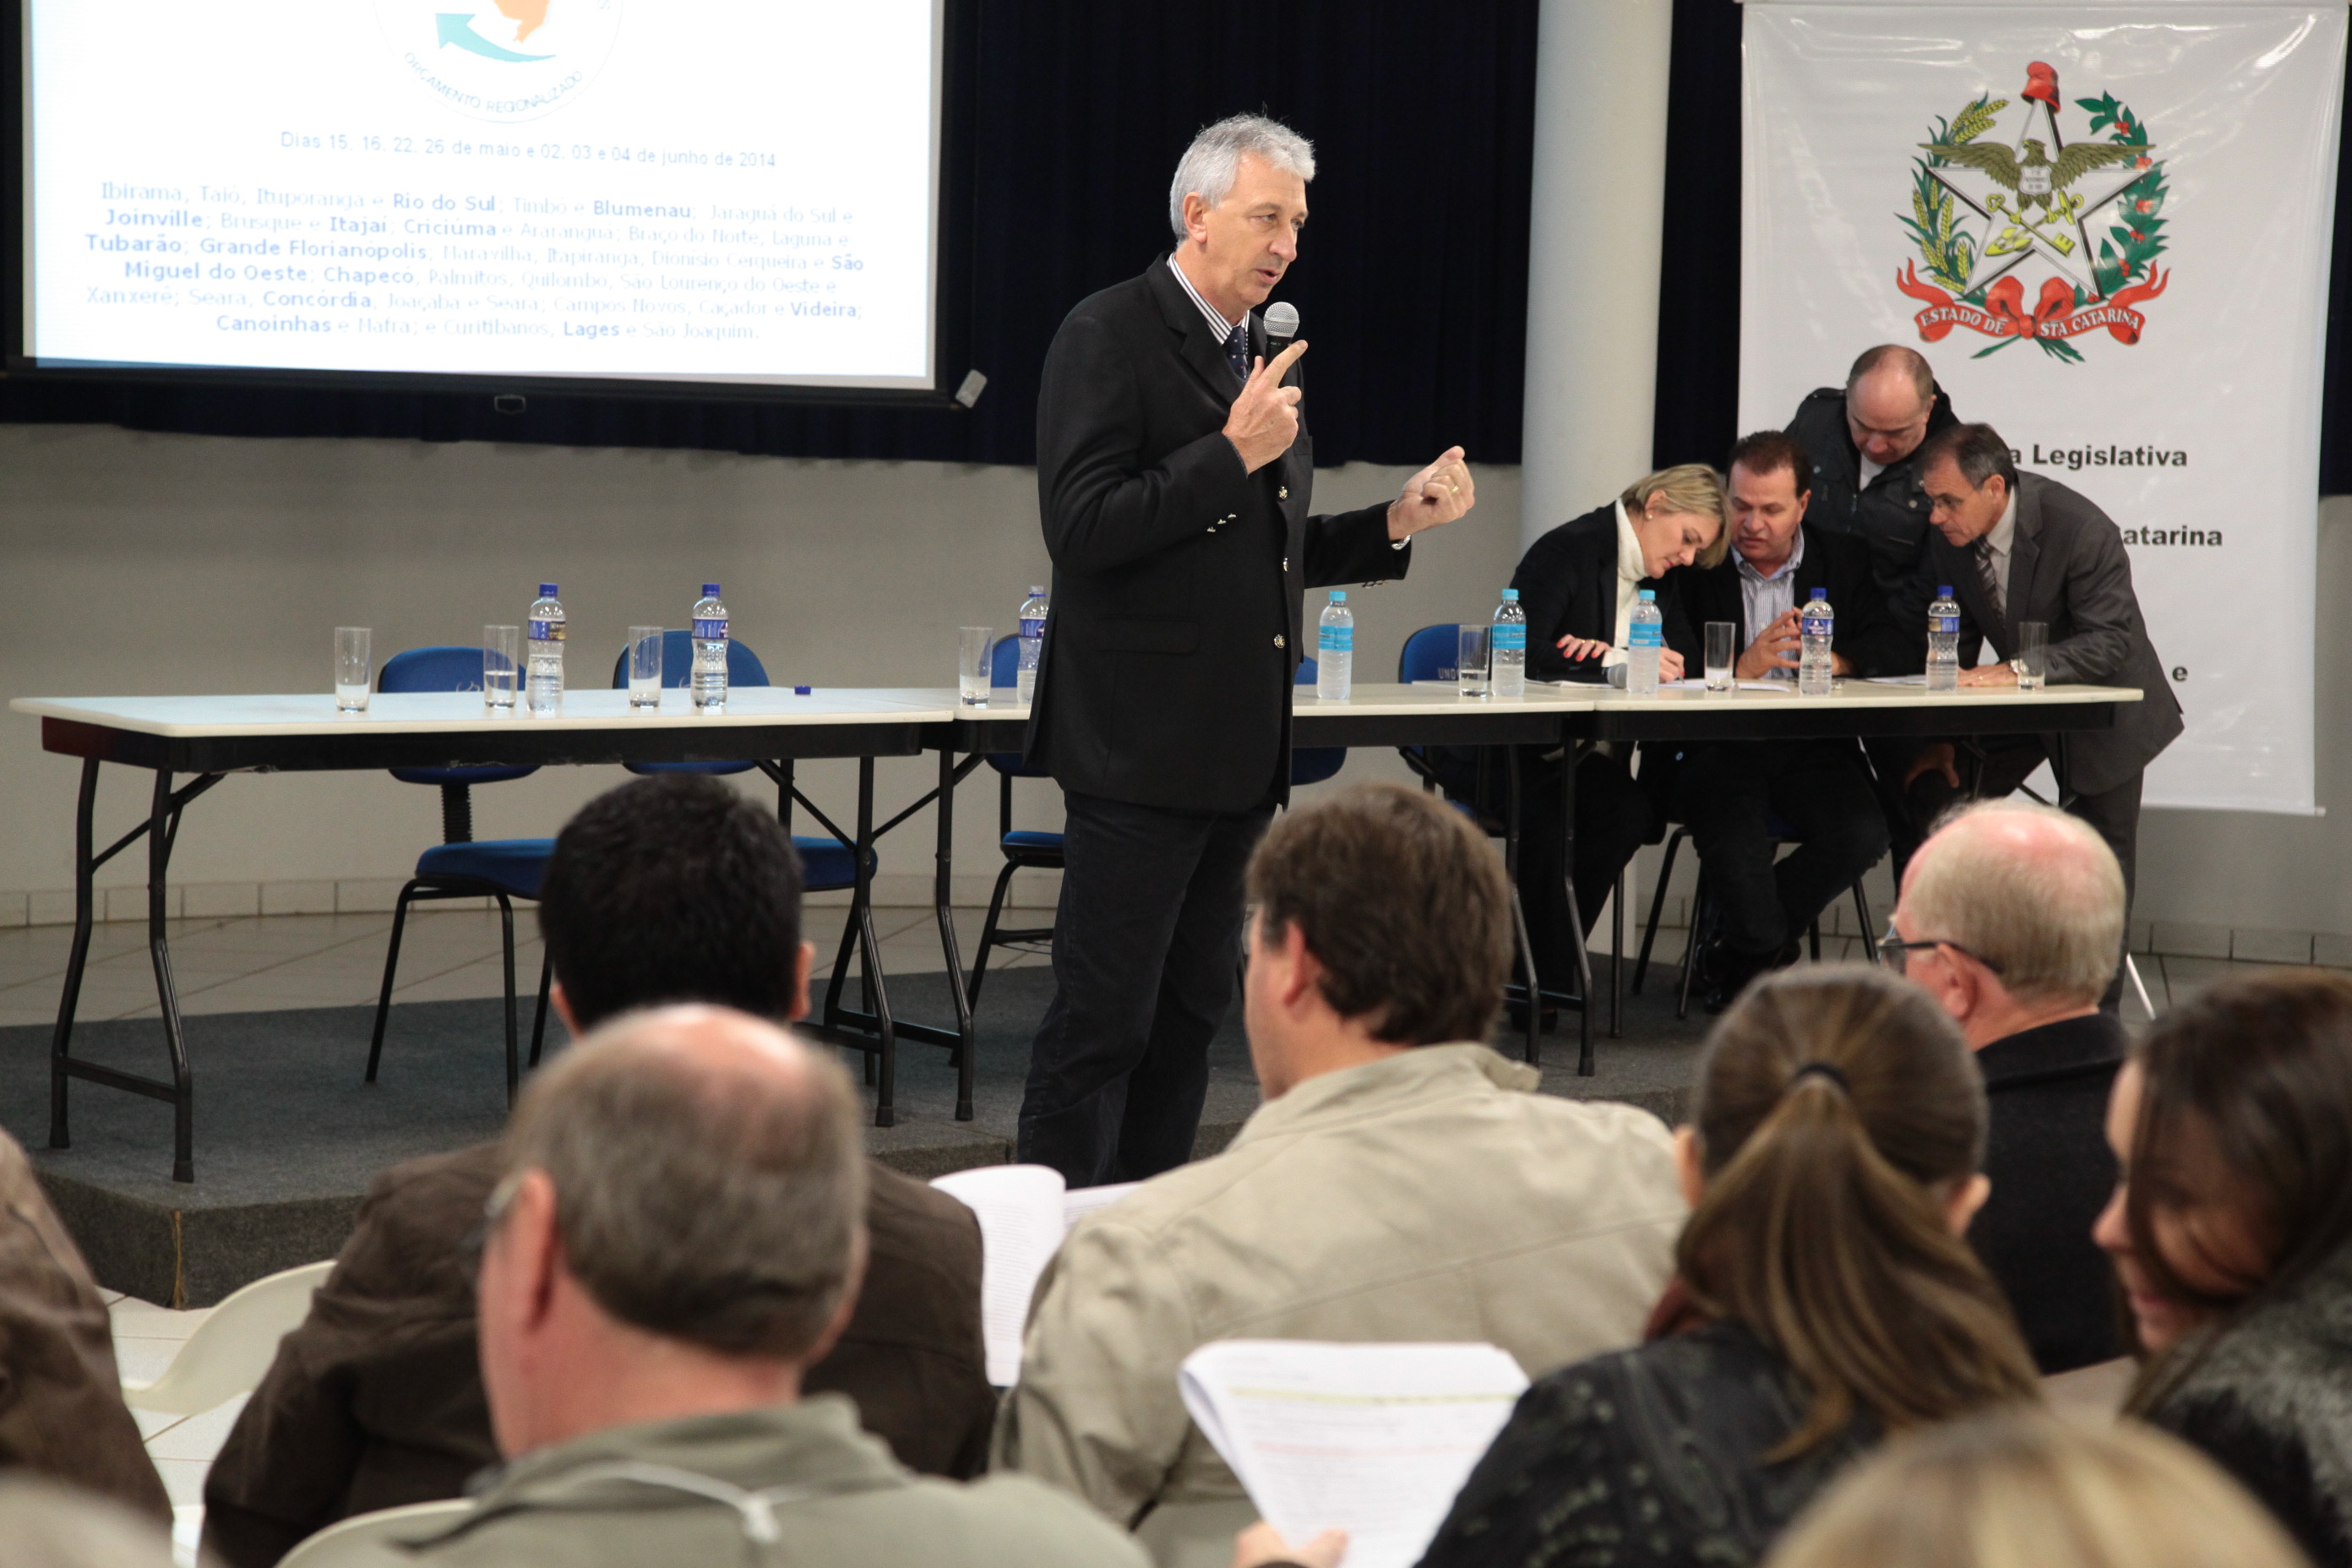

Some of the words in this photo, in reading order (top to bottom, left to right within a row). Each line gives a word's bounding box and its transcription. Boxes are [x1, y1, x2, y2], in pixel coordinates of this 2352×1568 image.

[487, 70, 583, 113] REGIONALIZADO
[280, 131, 321, 148] Dias
[425, 138, 445, 155] 26
[452, 139, 472, 155] de
[479, 141, 521, 157] maio
[526, 145, 535, 158] e
[572, 144, 591, 160] 03
[598, 149, 606, 161] e
[611, 146, 631, 161] 04
[637, 148, 656, 162] de
[662, 149, 708, 166] junho
[715, 151, 733, 166] de
[739, 152, 776, 167] 2014
[101, 181, 190, 204] Ibirama,
[372, 196, 384, 206] e
[393, 193, 424, 210] Rio
[432, 193, 456, 210] do
[574, 203, 585, 213] e
[783, 206, 804, 223] do
[809, 208, 836, 223] Sul
[842, 212, 853, 224] e
[220, 212, 302, 233] Brusque
[309, 219, 321, 229] e
[502, 225, 513, 236] e
[629, 226, 678, 245] Braço
[683, 226, 705, 243] do
[712, 229, 764, 246] Norte,
[772, 230, 832, 249] Laguna
[838, 236, 848, 247] e
[199, 237, 281, 256] Grande
[814, 258, 825, 270] e
[831, 253, 863, 271] São
[124, 259, 200, 282] Miguel
[208, 262, 237, 280] do
[428, 269, 513, 287] Palmitos,
[521, 271, 612, 290] Quilombo,
[620, 272, 652, 290] São
[661, 274, 738, 295] Lourenço
[744, 275, 765, 292] do
[772, 277, 819, 293] Oeste
[825, 282, 836, 293] e
[188, 287, 254, 308] Seara,
[468, 298, 479, 308] e
[486, 295, 546, 313] Seara;
[553, 297, 626, 315] Campos
[699, 299, 767, 318] Caçador
[774, 304, 786, 315] e
[216, 313, 331, 333] Canoinhas
[337, 320, 350, 330] e
[425, 323, 437, 333] e
[564, 320, 620, 340] Lages
[625, 325, 637, 336] e
[643, 321, 676, 338] São
[1919, 307, 1982, 327] ESTADO
[1983, 318, 2006, 335] DE
[2033, 444, 2188, 471] Legislativa
[2123, 525, 2223, 546] atarina
